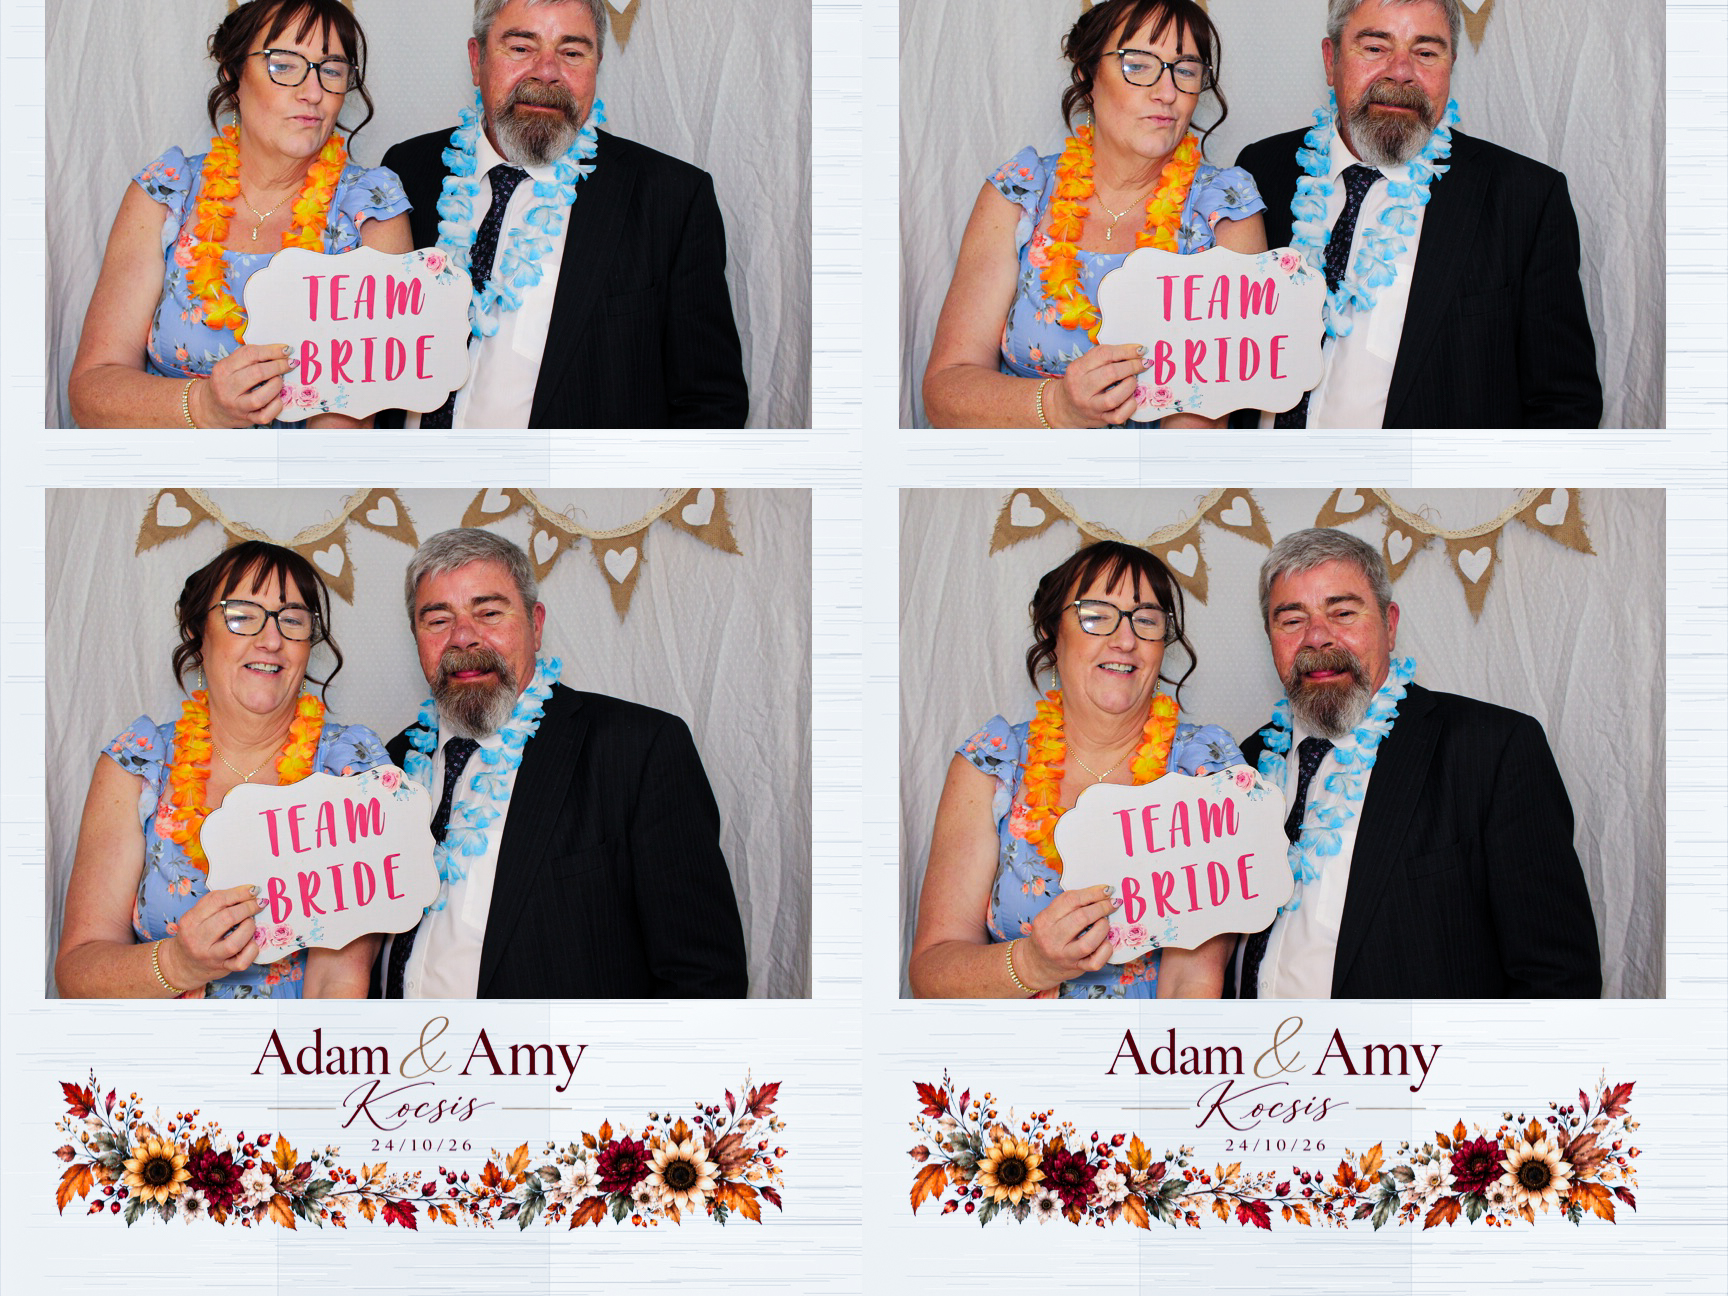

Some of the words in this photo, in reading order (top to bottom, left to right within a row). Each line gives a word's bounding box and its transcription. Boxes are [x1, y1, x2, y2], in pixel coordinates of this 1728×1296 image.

[302, 273, 426, 322] TEAM
[1156, 273, 1280, 322] TEAM
[300, 334, 436, 387] BRIDE
[1154, 334, 1290, 387] BRIDE
[258, 796, 387, 858] TEAM
[1112, 796, 1241, 858] TEAM
[267, 852, 406, 926] BRIDE
[1121, 852, 1260, 926] BRIDE
